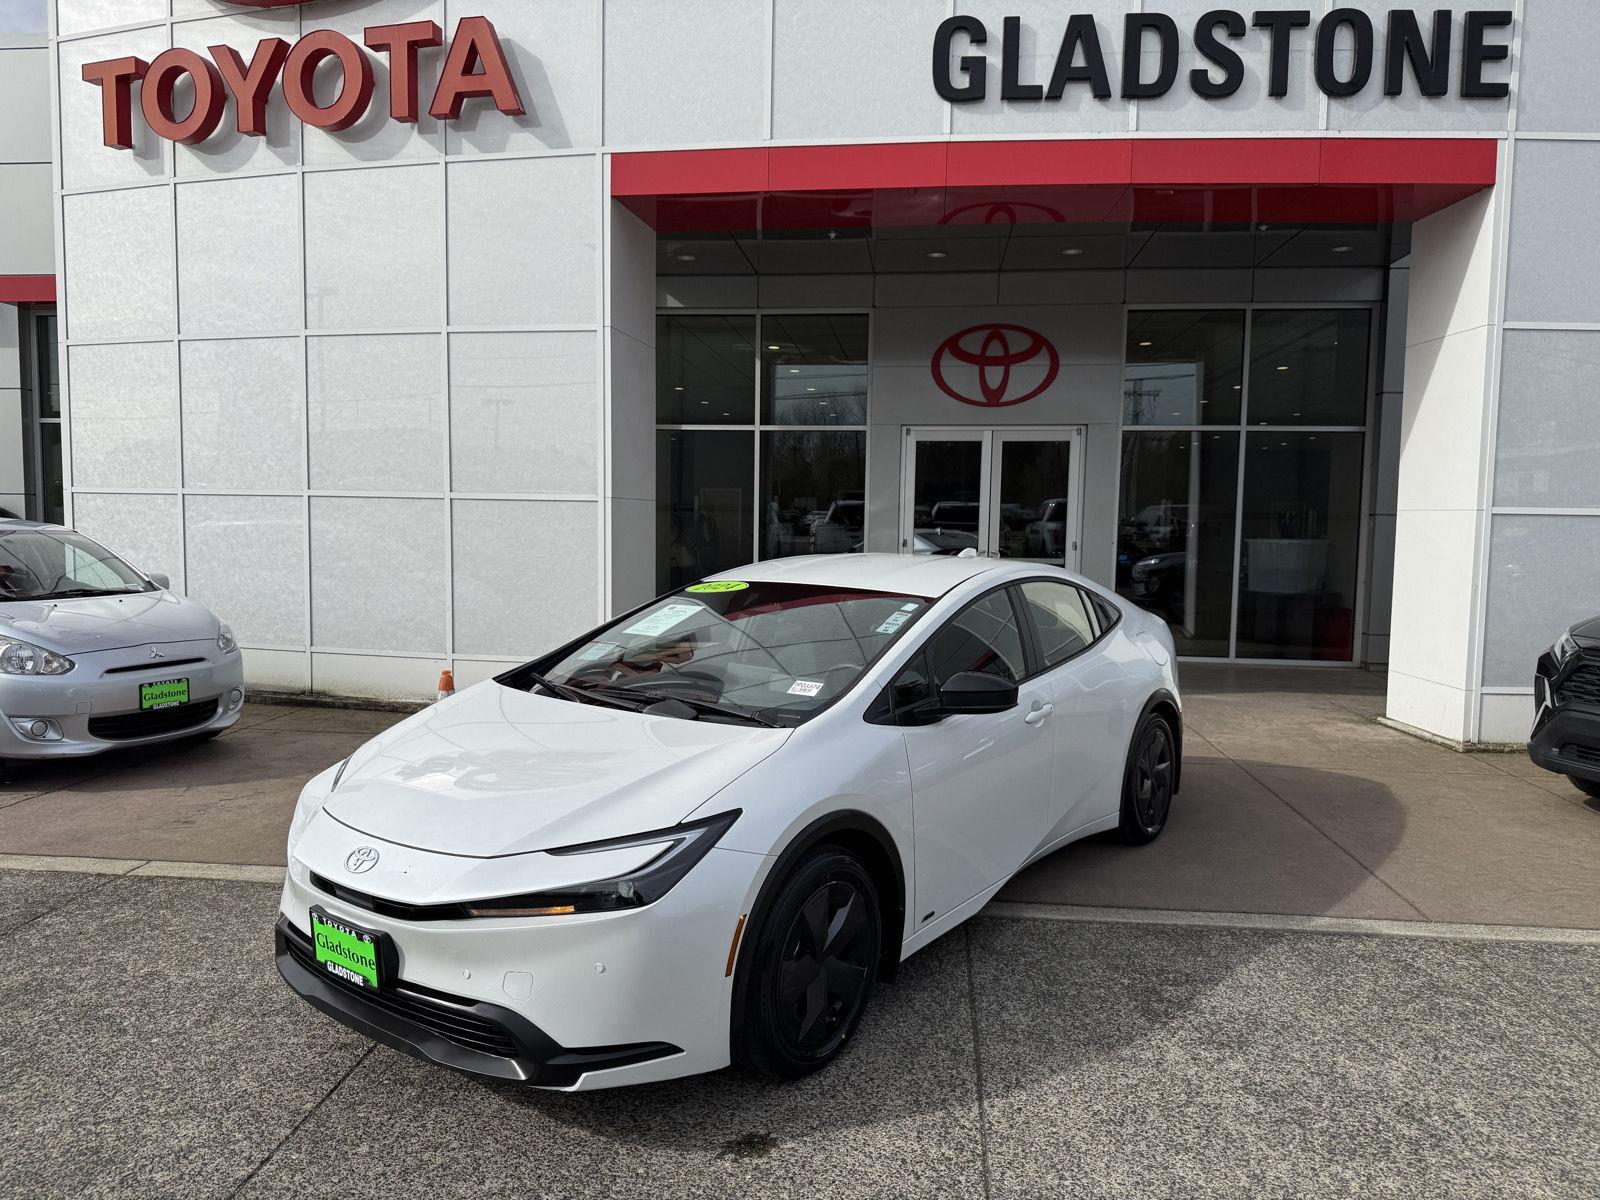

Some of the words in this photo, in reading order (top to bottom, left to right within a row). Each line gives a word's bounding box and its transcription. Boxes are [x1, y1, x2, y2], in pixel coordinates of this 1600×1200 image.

[932, 8, 1513, 101] GLADSTONE
[81, 15, 527, 150] TOYOTA
[152, 679, 178, 687] TOYOTA
[143, 689, 187, 701] Gladstone
[152, 700, 180, 709] GLADSTONE
[322, 917, 357, 938] TOYOTA
[316, 932, 376, 970] Gladstone
[326, 961, 364, 987] GLADSTONE
